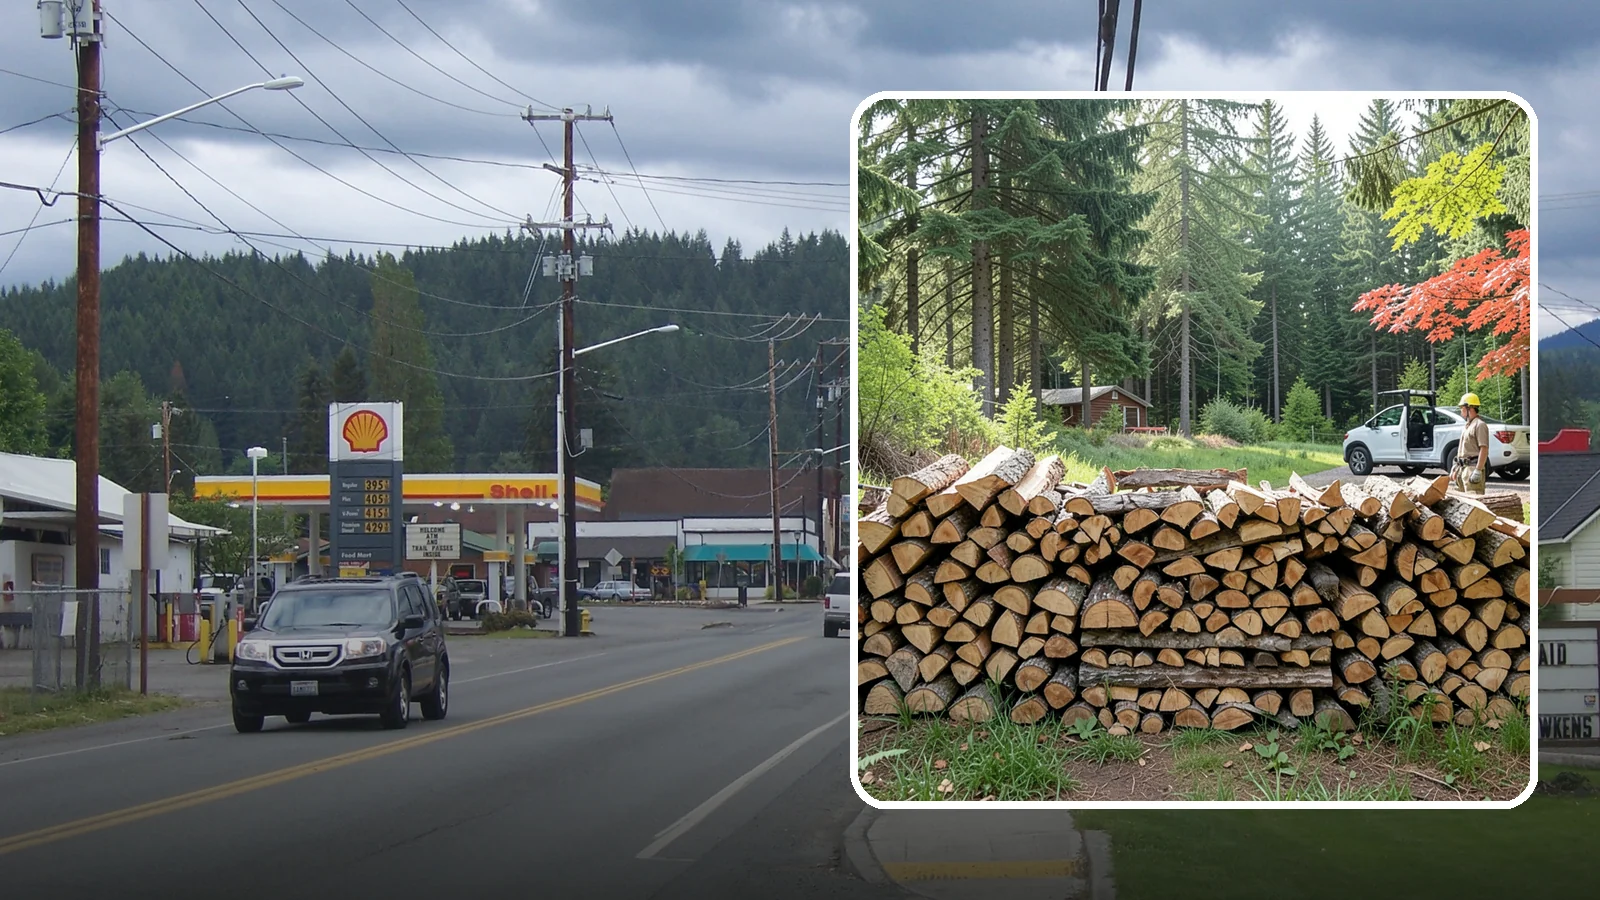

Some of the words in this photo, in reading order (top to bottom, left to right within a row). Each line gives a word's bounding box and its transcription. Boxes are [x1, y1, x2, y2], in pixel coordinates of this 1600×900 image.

[366, 480, 383, 490] 395
[490, 484, 547, 499] Shell
[366, 494, 383, 504] 405
[366, 508, 383, 518] 415
[366, 522, 383, 533] 429
